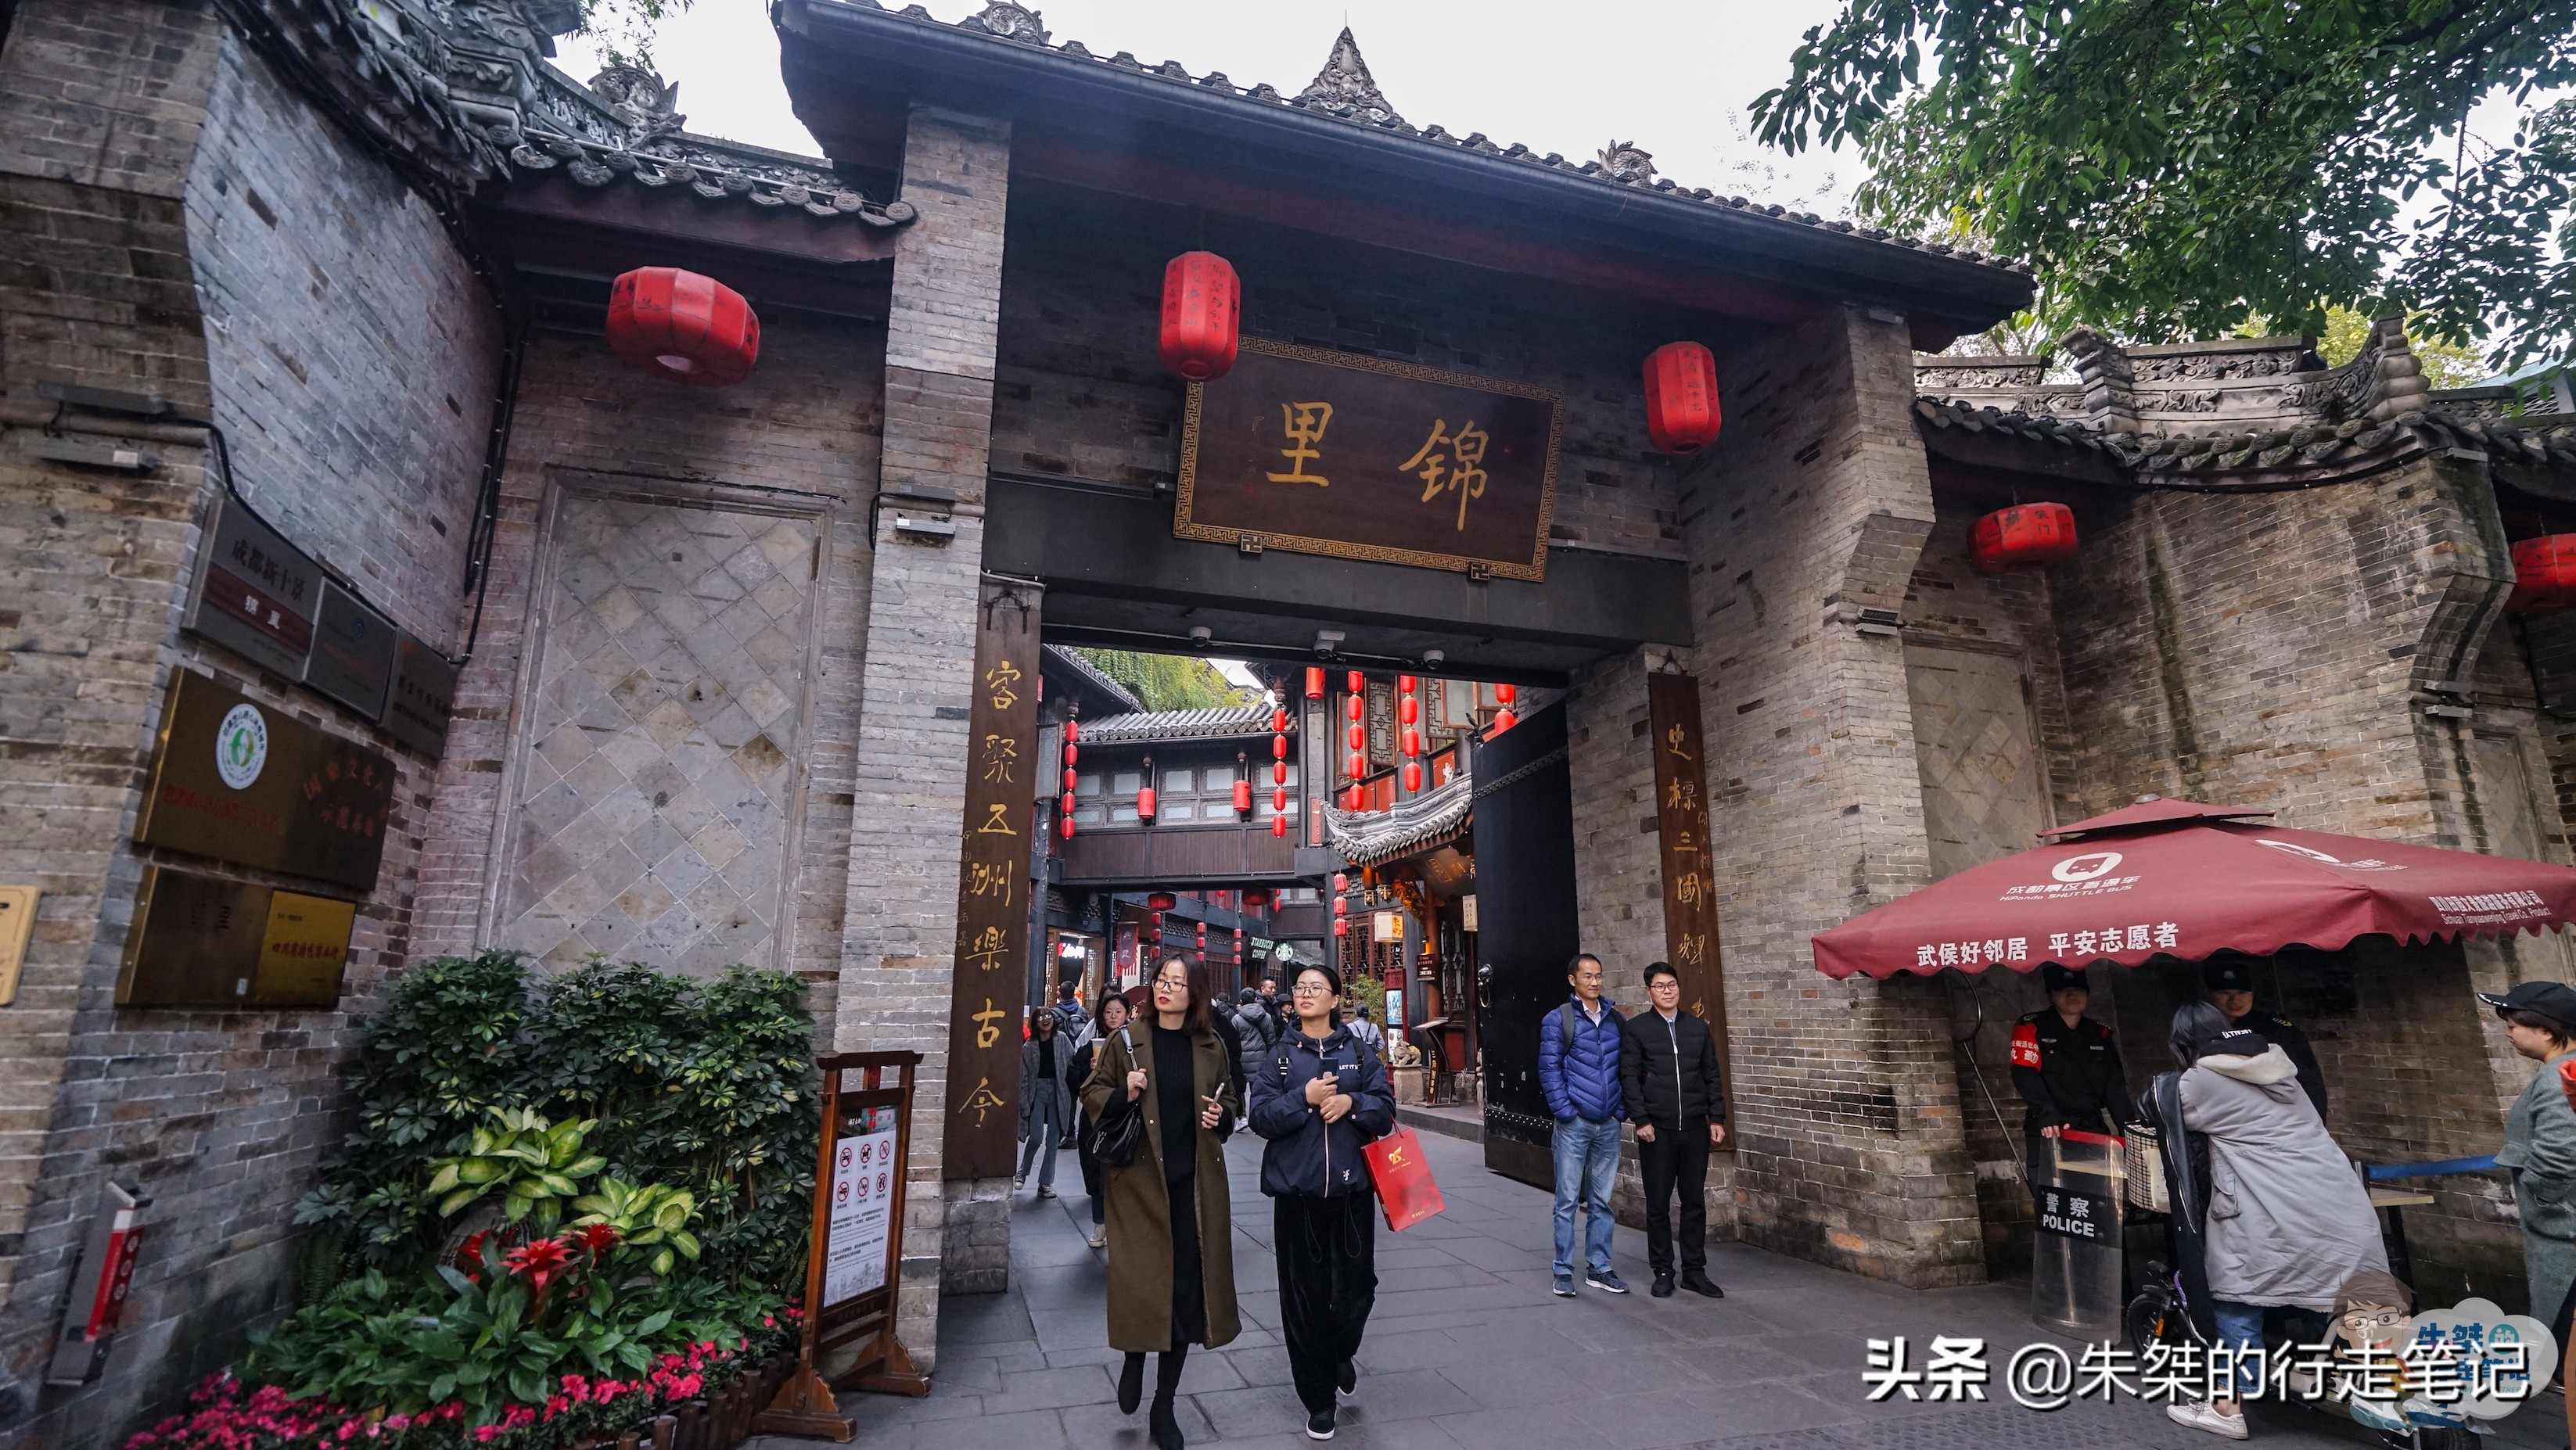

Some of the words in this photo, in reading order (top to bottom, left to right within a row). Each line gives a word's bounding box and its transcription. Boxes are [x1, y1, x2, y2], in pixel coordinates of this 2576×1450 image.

[2006, 875, 2142, 895] 成都景区直通车
[2048, 888, 2104, 899] SHUTTLE
[2107, 885, 2133, 894] BUS
[2441, 913, 2465, 925] Sichuan
[1250, 937, 1274, 950] STARBUCKS
[1917, 936, 2028, 967] 武侯好邻居
[2048, 921, 2179, 958] 平安志愿者
[1252, 949, 1266, 960] COFFEE
[2046, 1192, 2089, 1219] 警察
[2042, 1213, 2095, 1237] POLICE
